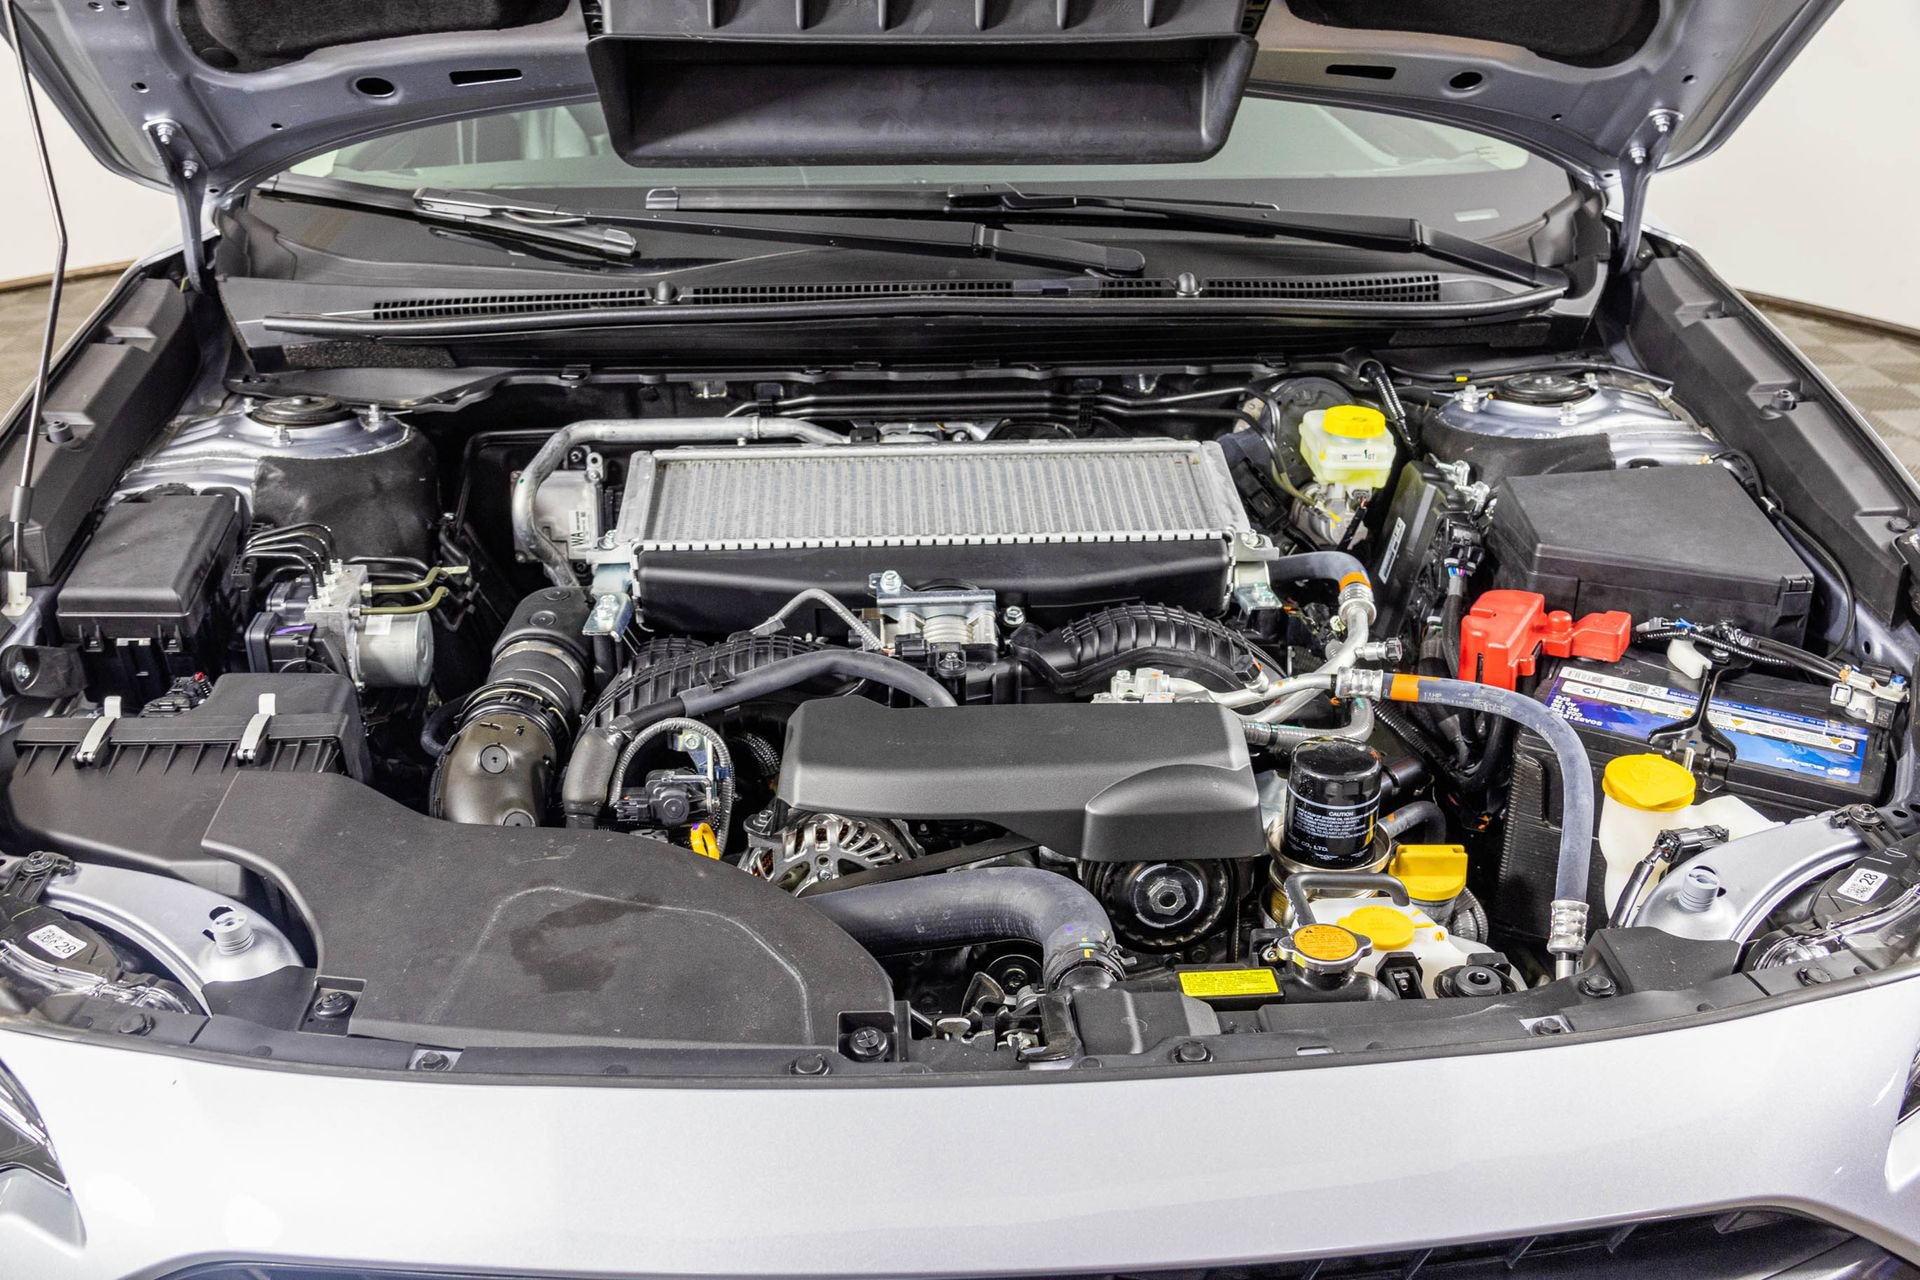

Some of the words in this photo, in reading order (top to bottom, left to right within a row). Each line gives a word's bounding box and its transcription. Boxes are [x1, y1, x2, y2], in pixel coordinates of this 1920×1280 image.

[570, 531, 585, 547] WA
[1776, 757, 1825, 770] SUBARU
[1859, 872, 1879, 886] 28
[54, 941, 76, 954] 28
